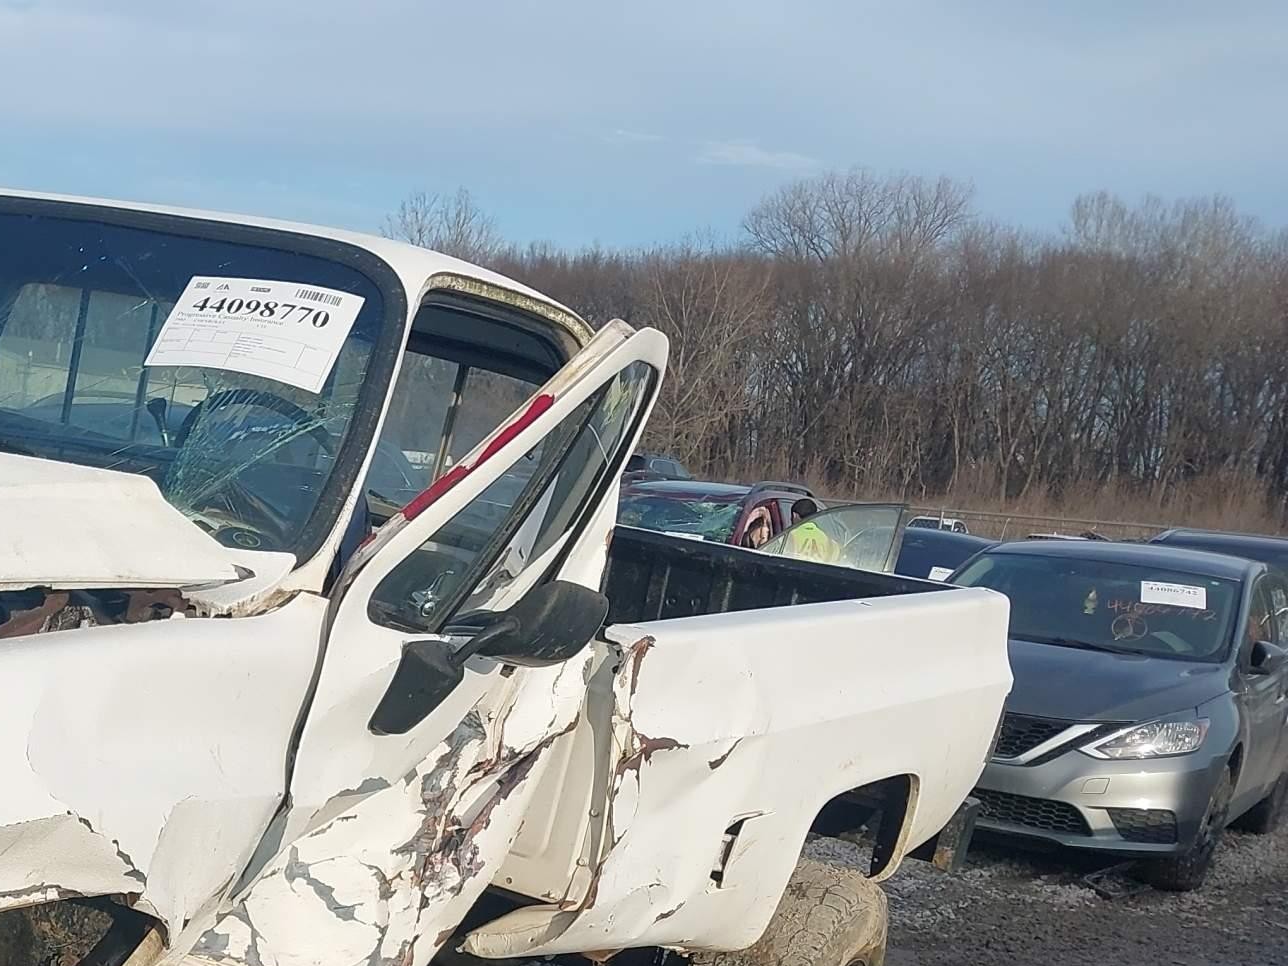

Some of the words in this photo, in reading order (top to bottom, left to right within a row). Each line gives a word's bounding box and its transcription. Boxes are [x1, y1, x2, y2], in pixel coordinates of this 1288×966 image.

[177, 311, 216, 320] Progressive
[218, 313, 249, 322] Casualty
[249, 316, 284, 326] Insurance
[192, 296, 330, 329] 44098770
